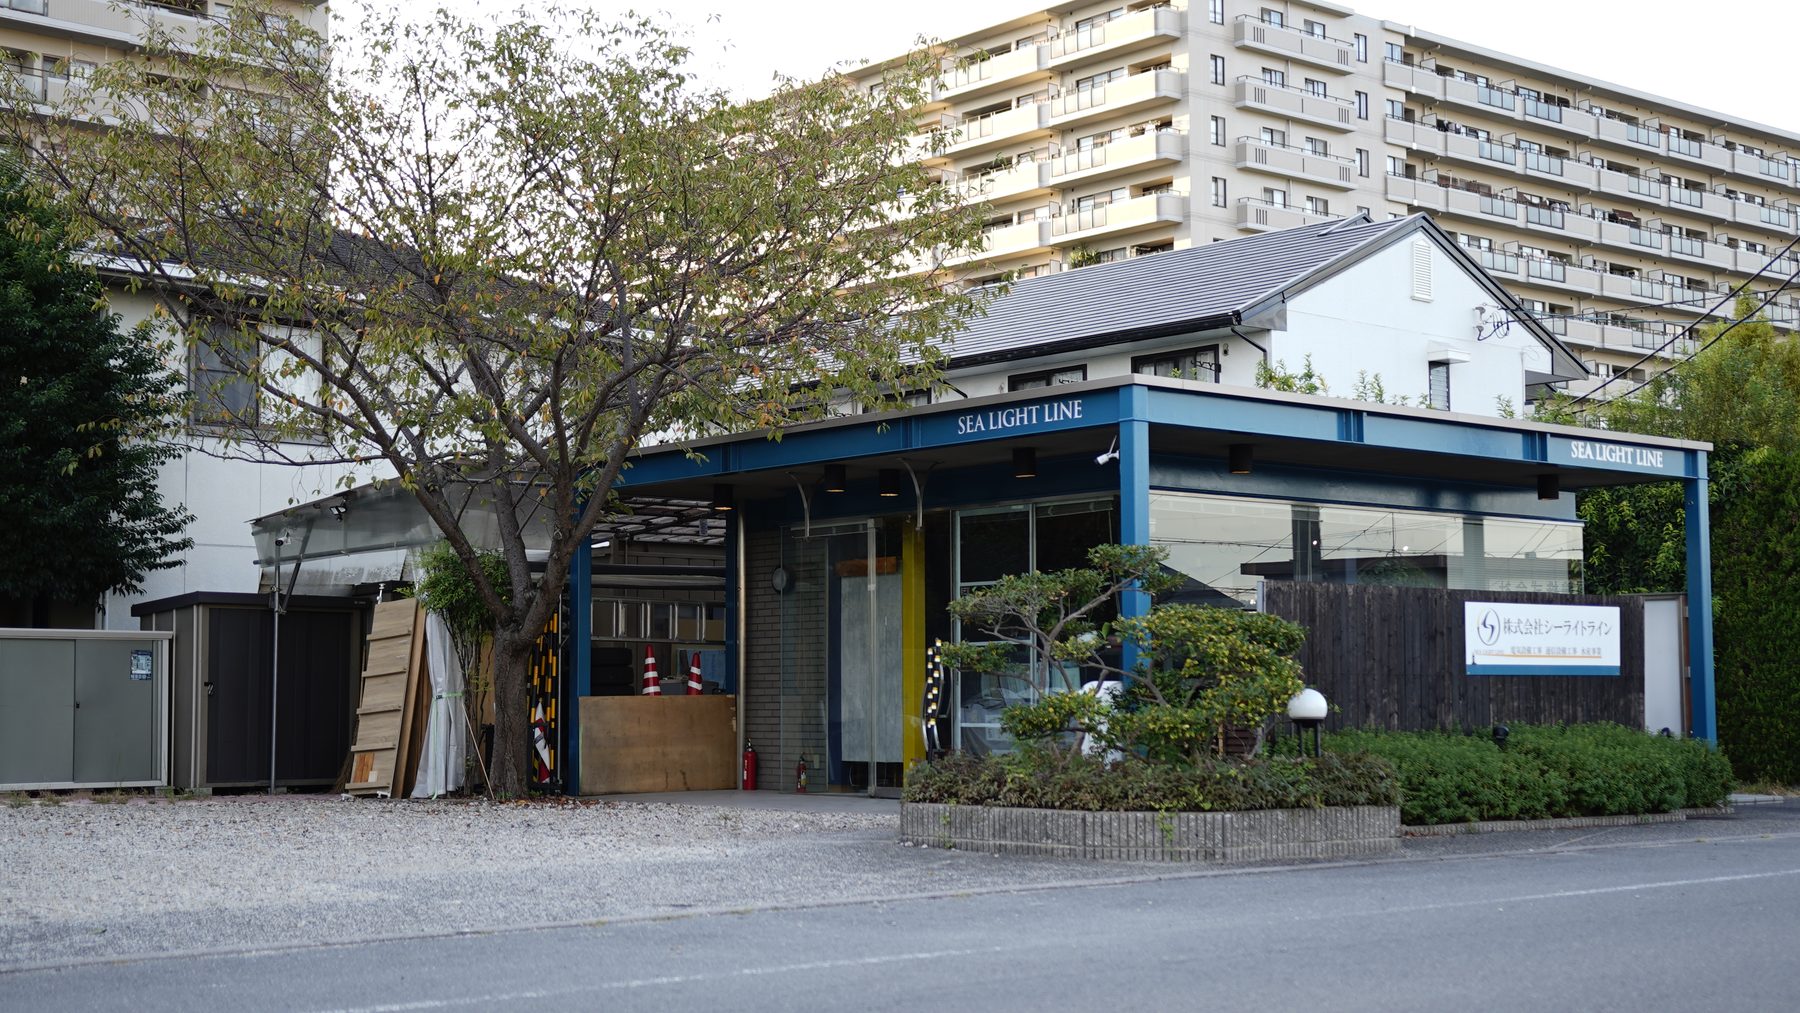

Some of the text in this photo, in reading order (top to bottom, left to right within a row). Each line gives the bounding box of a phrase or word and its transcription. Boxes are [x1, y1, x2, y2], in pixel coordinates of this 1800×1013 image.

[958, 400, 1083, 434] SEA LIGHT LINE
[1571, 441, 1664, 468] SEA LIGHT LINE
[1503, 617, 1612, 636] 株式会社シーライトライン
